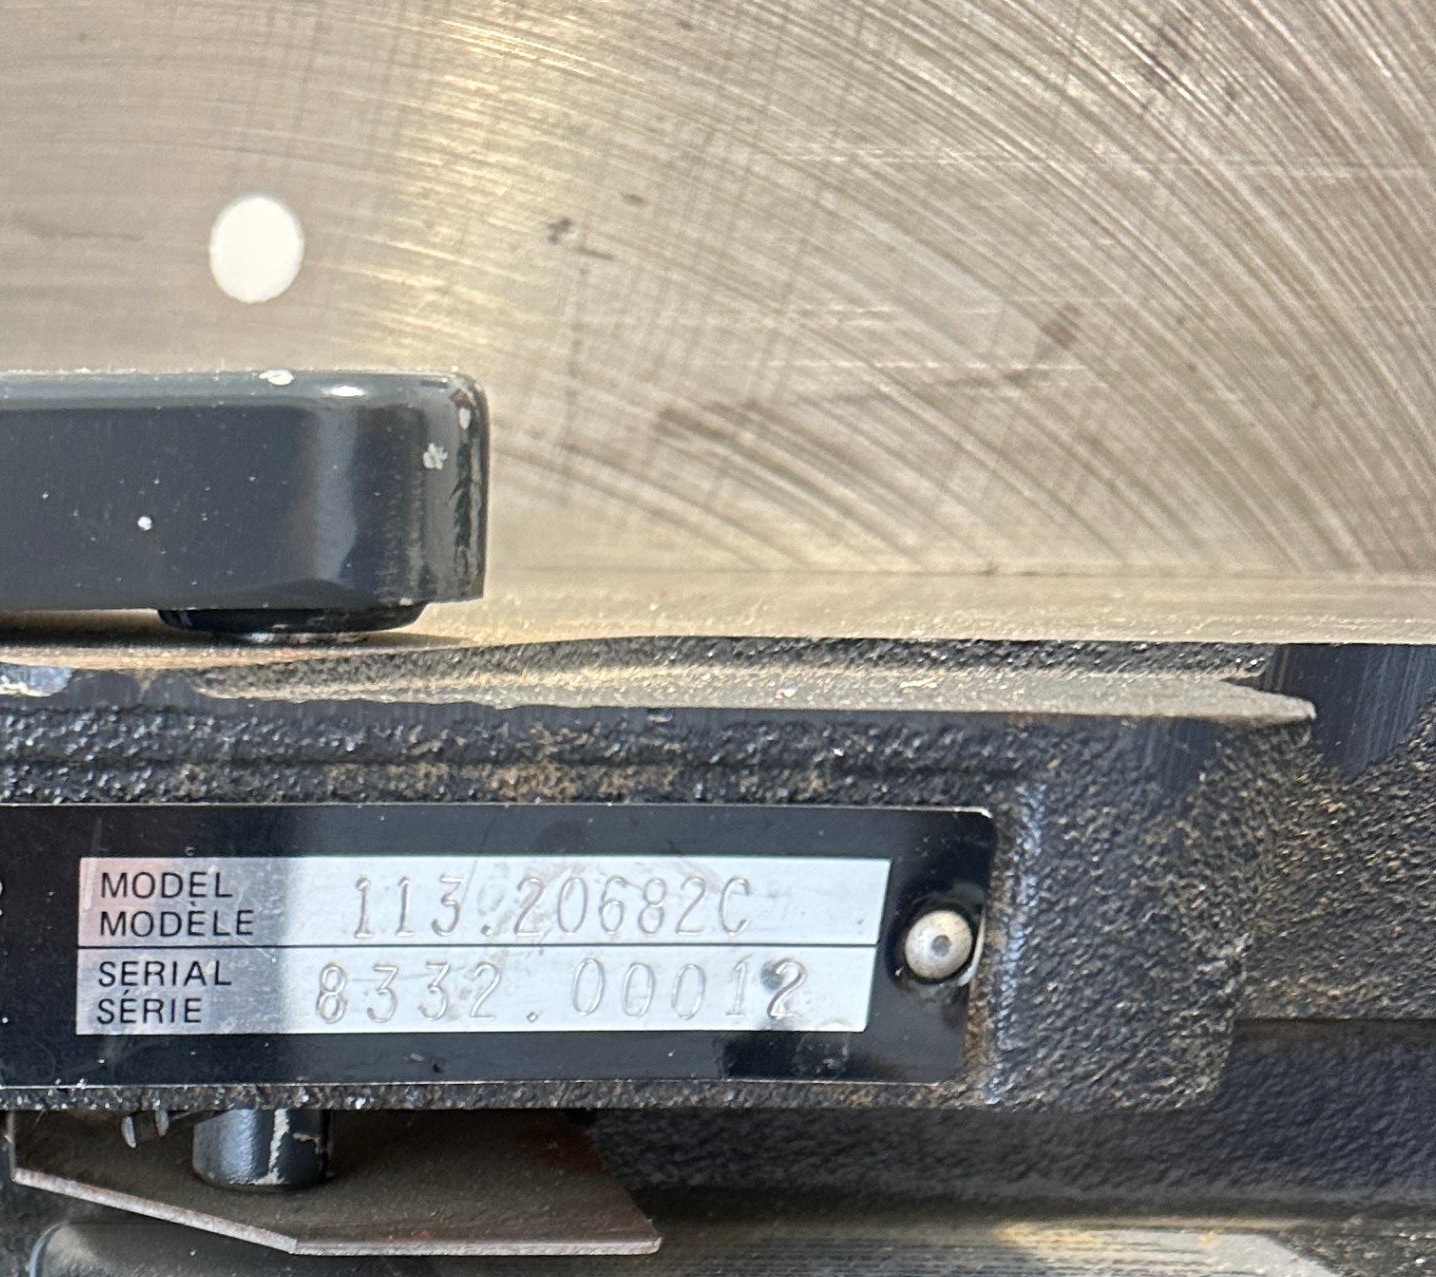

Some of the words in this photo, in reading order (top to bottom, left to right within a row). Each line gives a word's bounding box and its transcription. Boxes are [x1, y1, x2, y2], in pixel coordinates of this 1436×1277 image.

[100, 871, 233, 899] MODEL
[99, 901, 255, 937] MODÈLE
[98, 961, 233, 987] SERIAL
[316, 957, 806, 1023] 8332.00012
[97, 989, 202, 1025] SÉRIE
